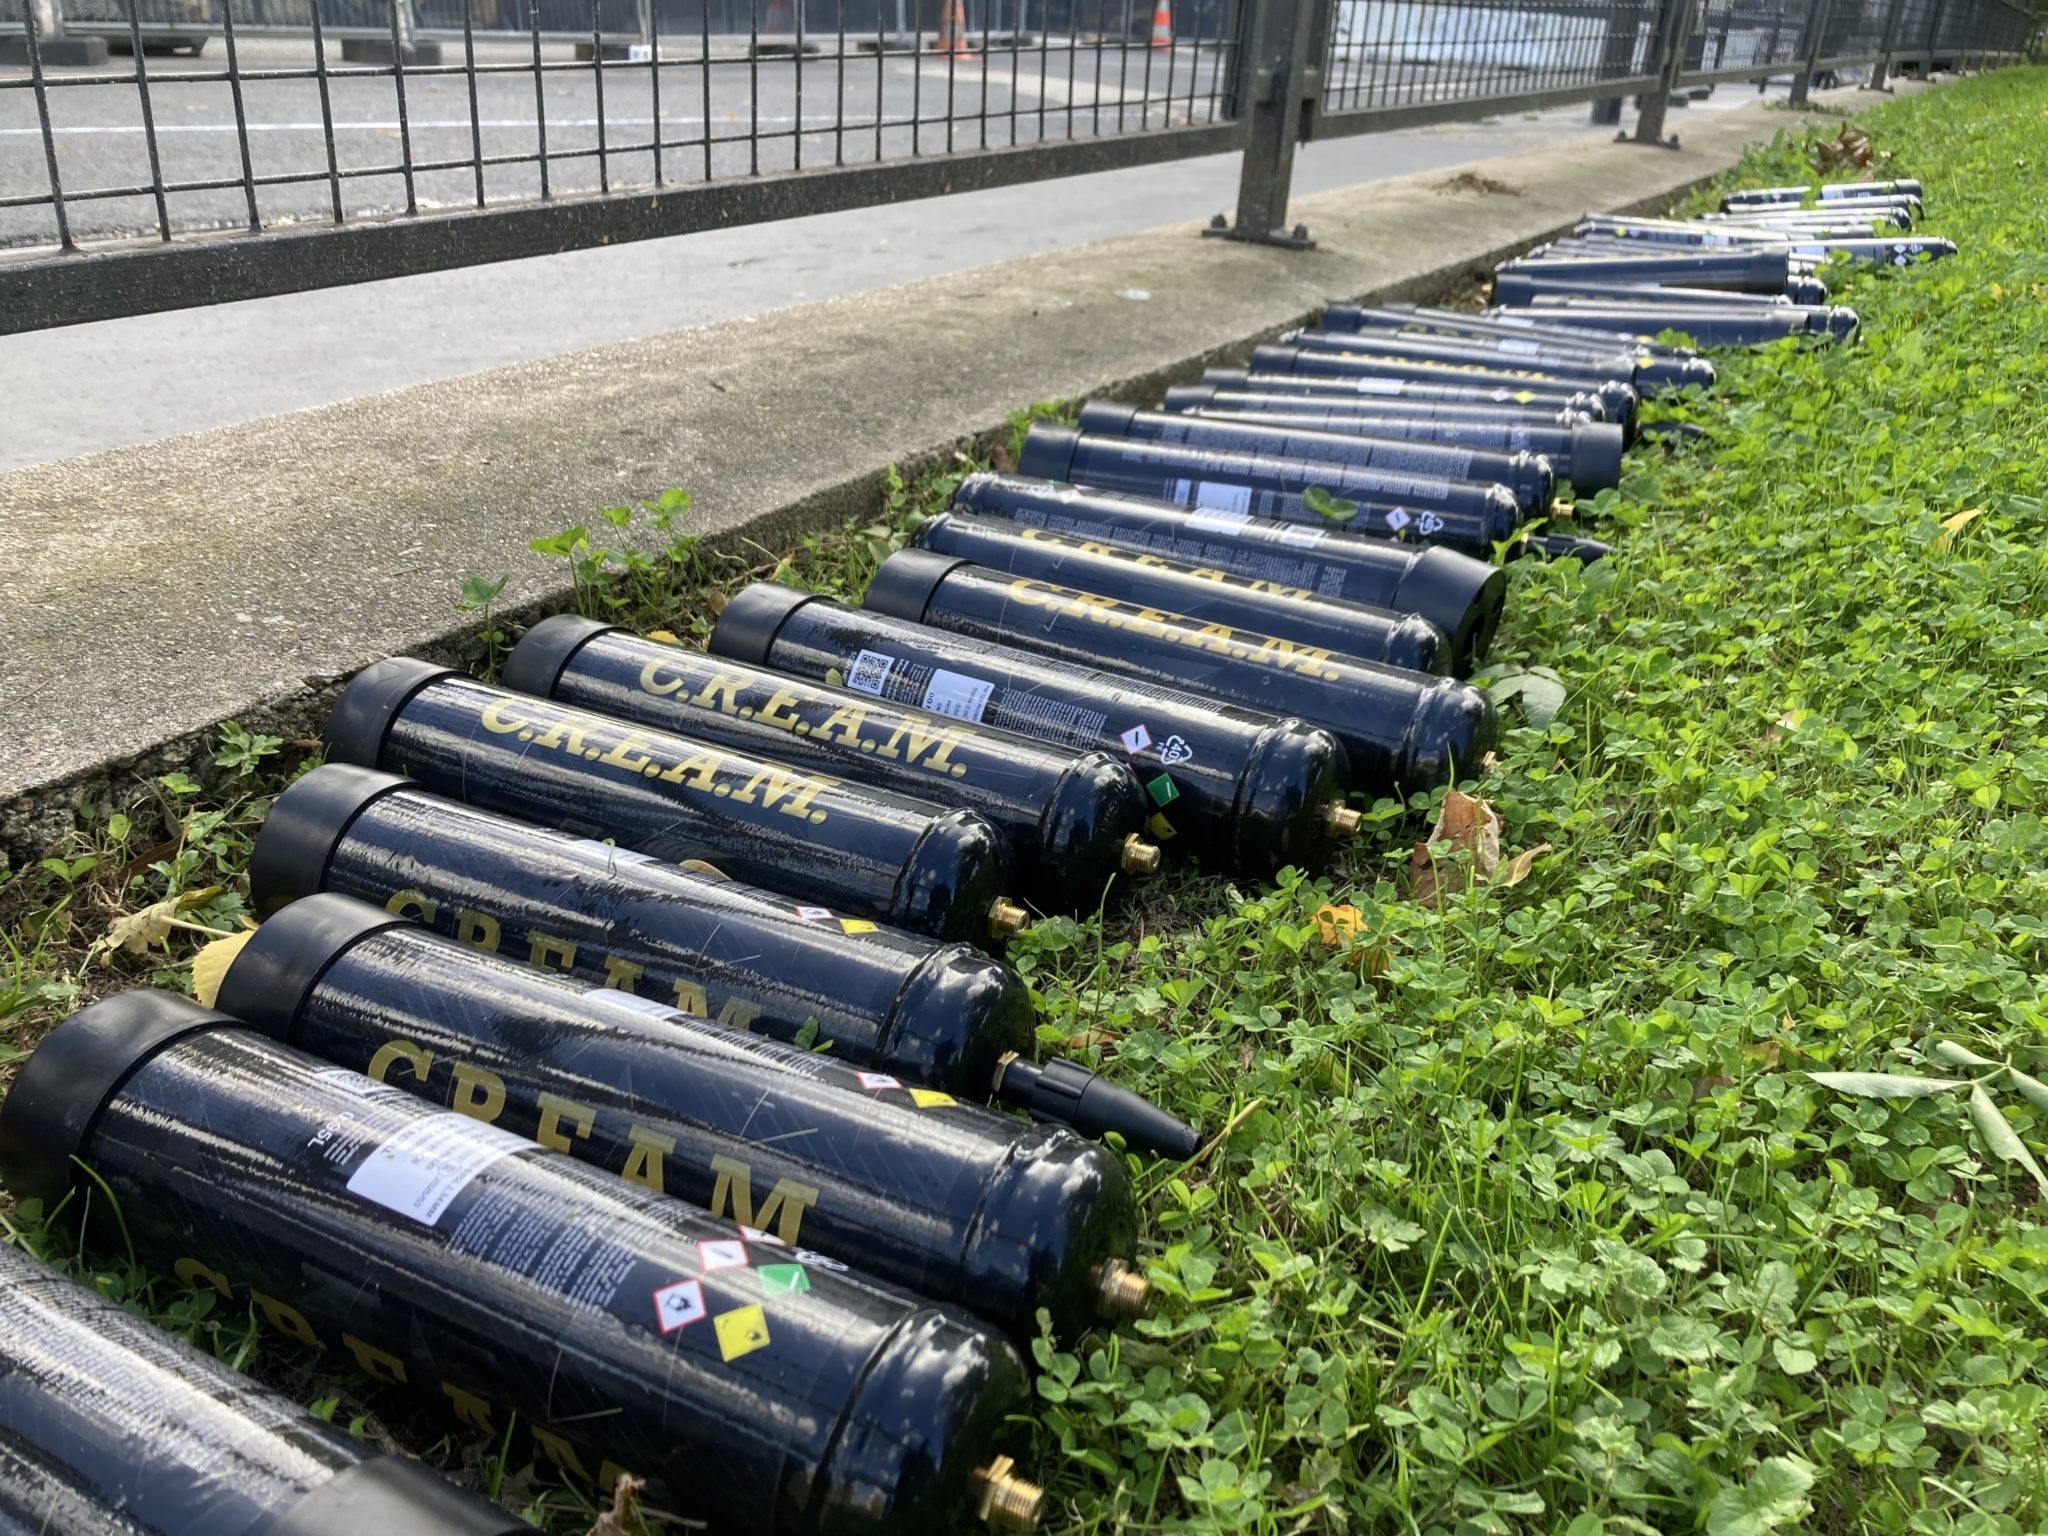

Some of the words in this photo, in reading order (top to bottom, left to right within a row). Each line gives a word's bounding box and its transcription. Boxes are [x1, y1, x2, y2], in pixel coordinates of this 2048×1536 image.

[480, 696, 842, 825] C.R.E.A.M.
[639, 656, 977, 778] C.R.E.A.M.
[306, 1110, 355, 1149] 095L
